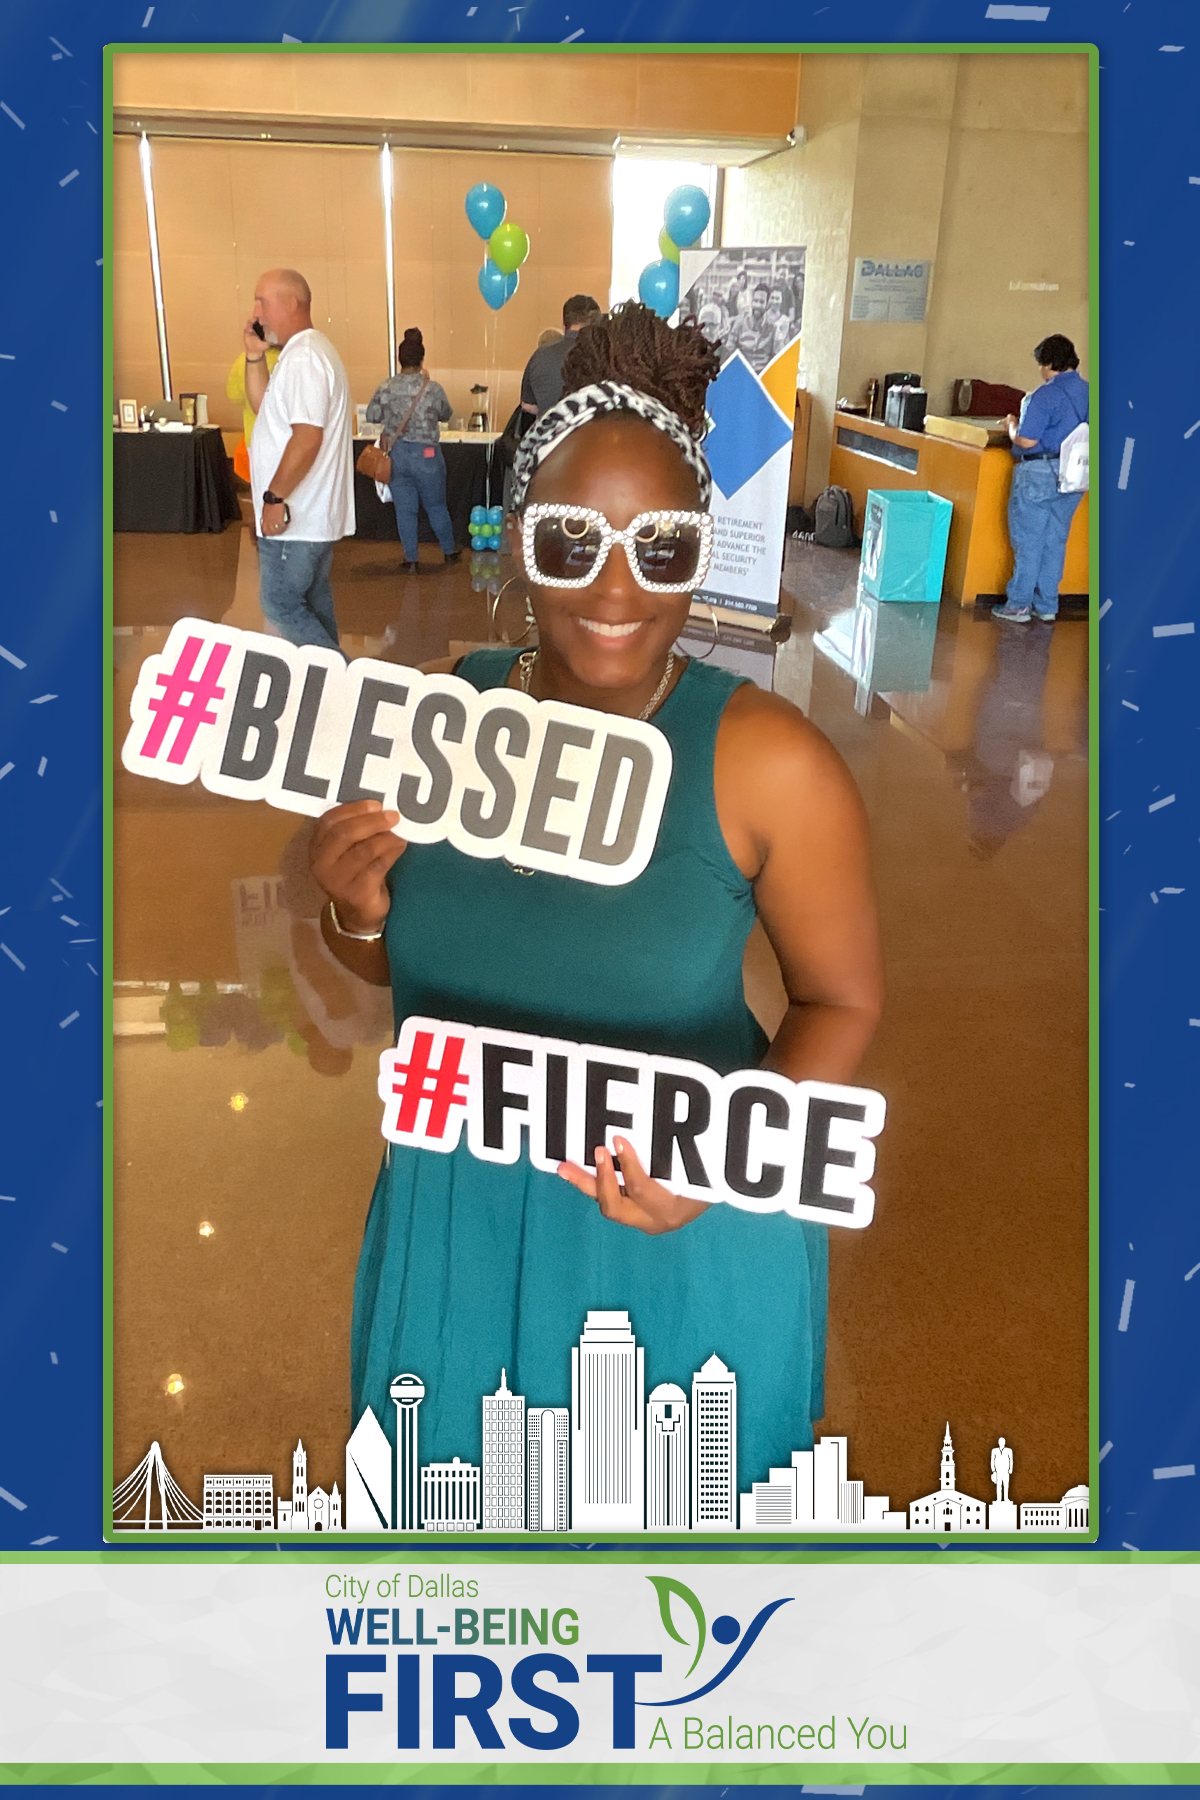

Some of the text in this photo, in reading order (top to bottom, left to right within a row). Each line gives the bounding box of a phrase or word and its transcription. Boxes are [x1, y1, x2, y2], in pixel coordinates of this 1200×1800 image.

[717, 515, 763, 530] RETIREMENT
[729, 529, 766, 543] SUPERIOR
[717, 540, 767, 555] ADVANCE THE
[722, 552, 757, 566] SECURITY
[139, 636, 654, 867] #BLESSED
